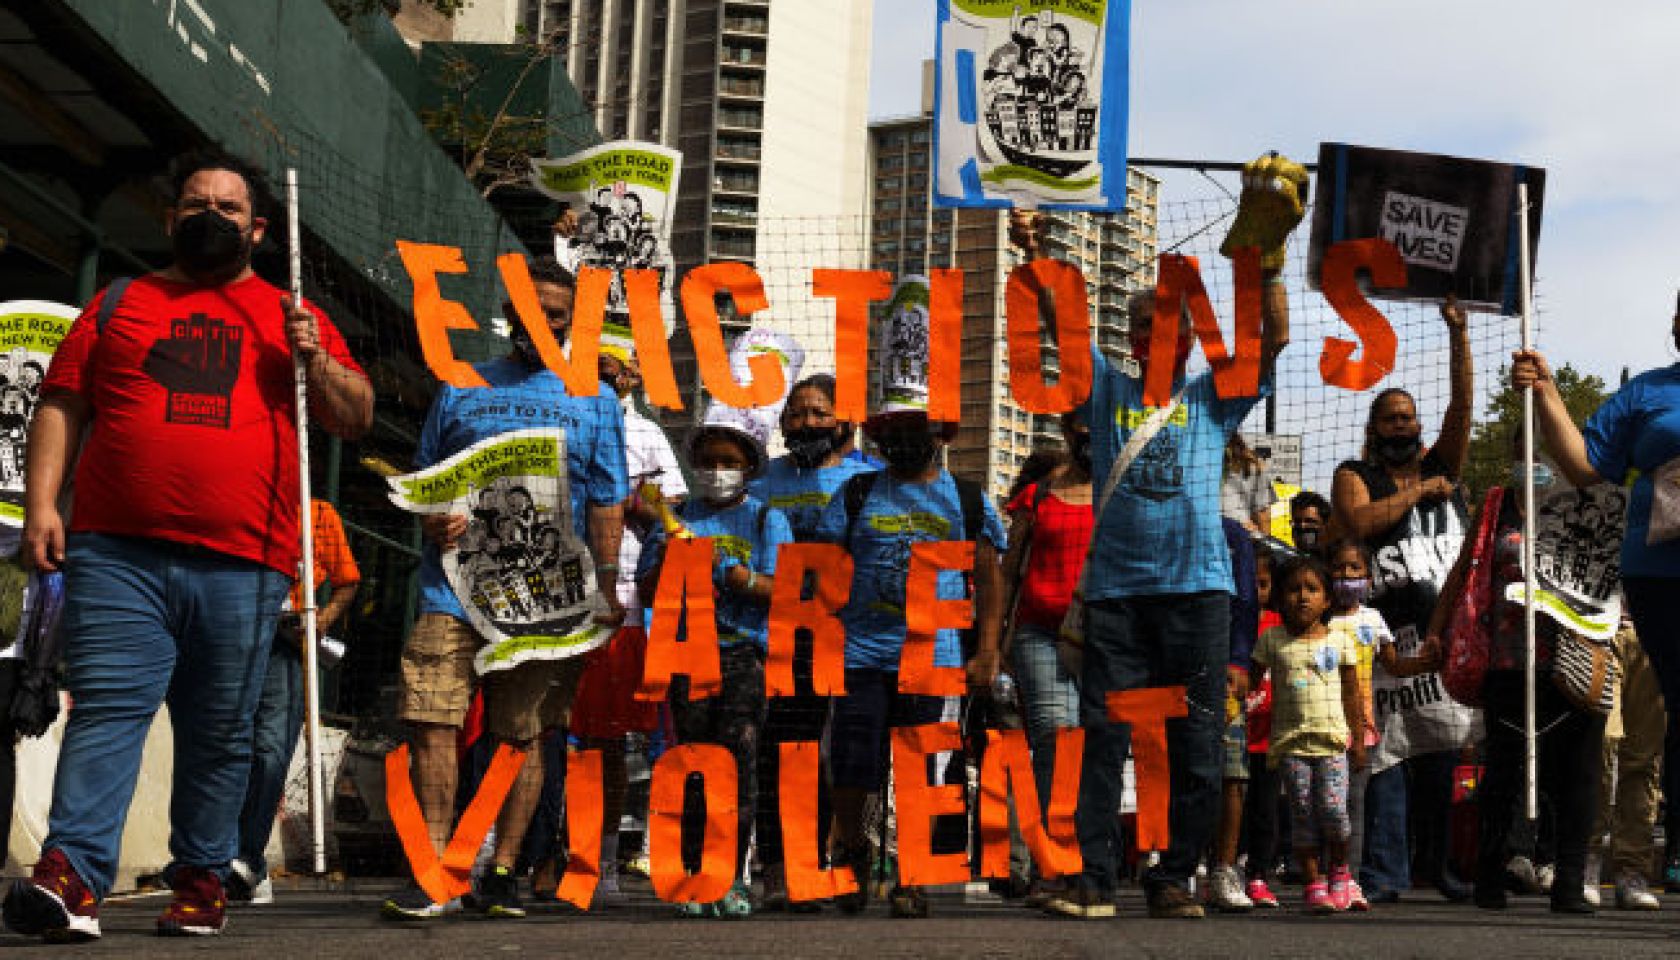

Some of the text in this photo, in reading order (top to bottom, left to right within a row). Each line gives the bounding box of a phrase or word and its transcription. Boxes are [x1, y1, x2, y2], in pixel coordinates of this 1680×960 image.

[592, 154, 622, 172] THE
[625, 154, 669, 173] ROAD
[602, 169, 665, 184] NEW YORK
[1386, 200, 1461, 237] SAVE
[1381, 226, 1454, 265] IVES
[0, 317, 67, 337] HE ROA
[1, 333, 34, 345] NEW
[396, 237, 1408, 423] EVICTIONS
[420, 443, 553, 496] MAKE THE ROAD
[633, 536, 976, 702] ARE
[1376, 672, 1443, 716] Profit
[385, 686, 1190, 911] VIOLENT
